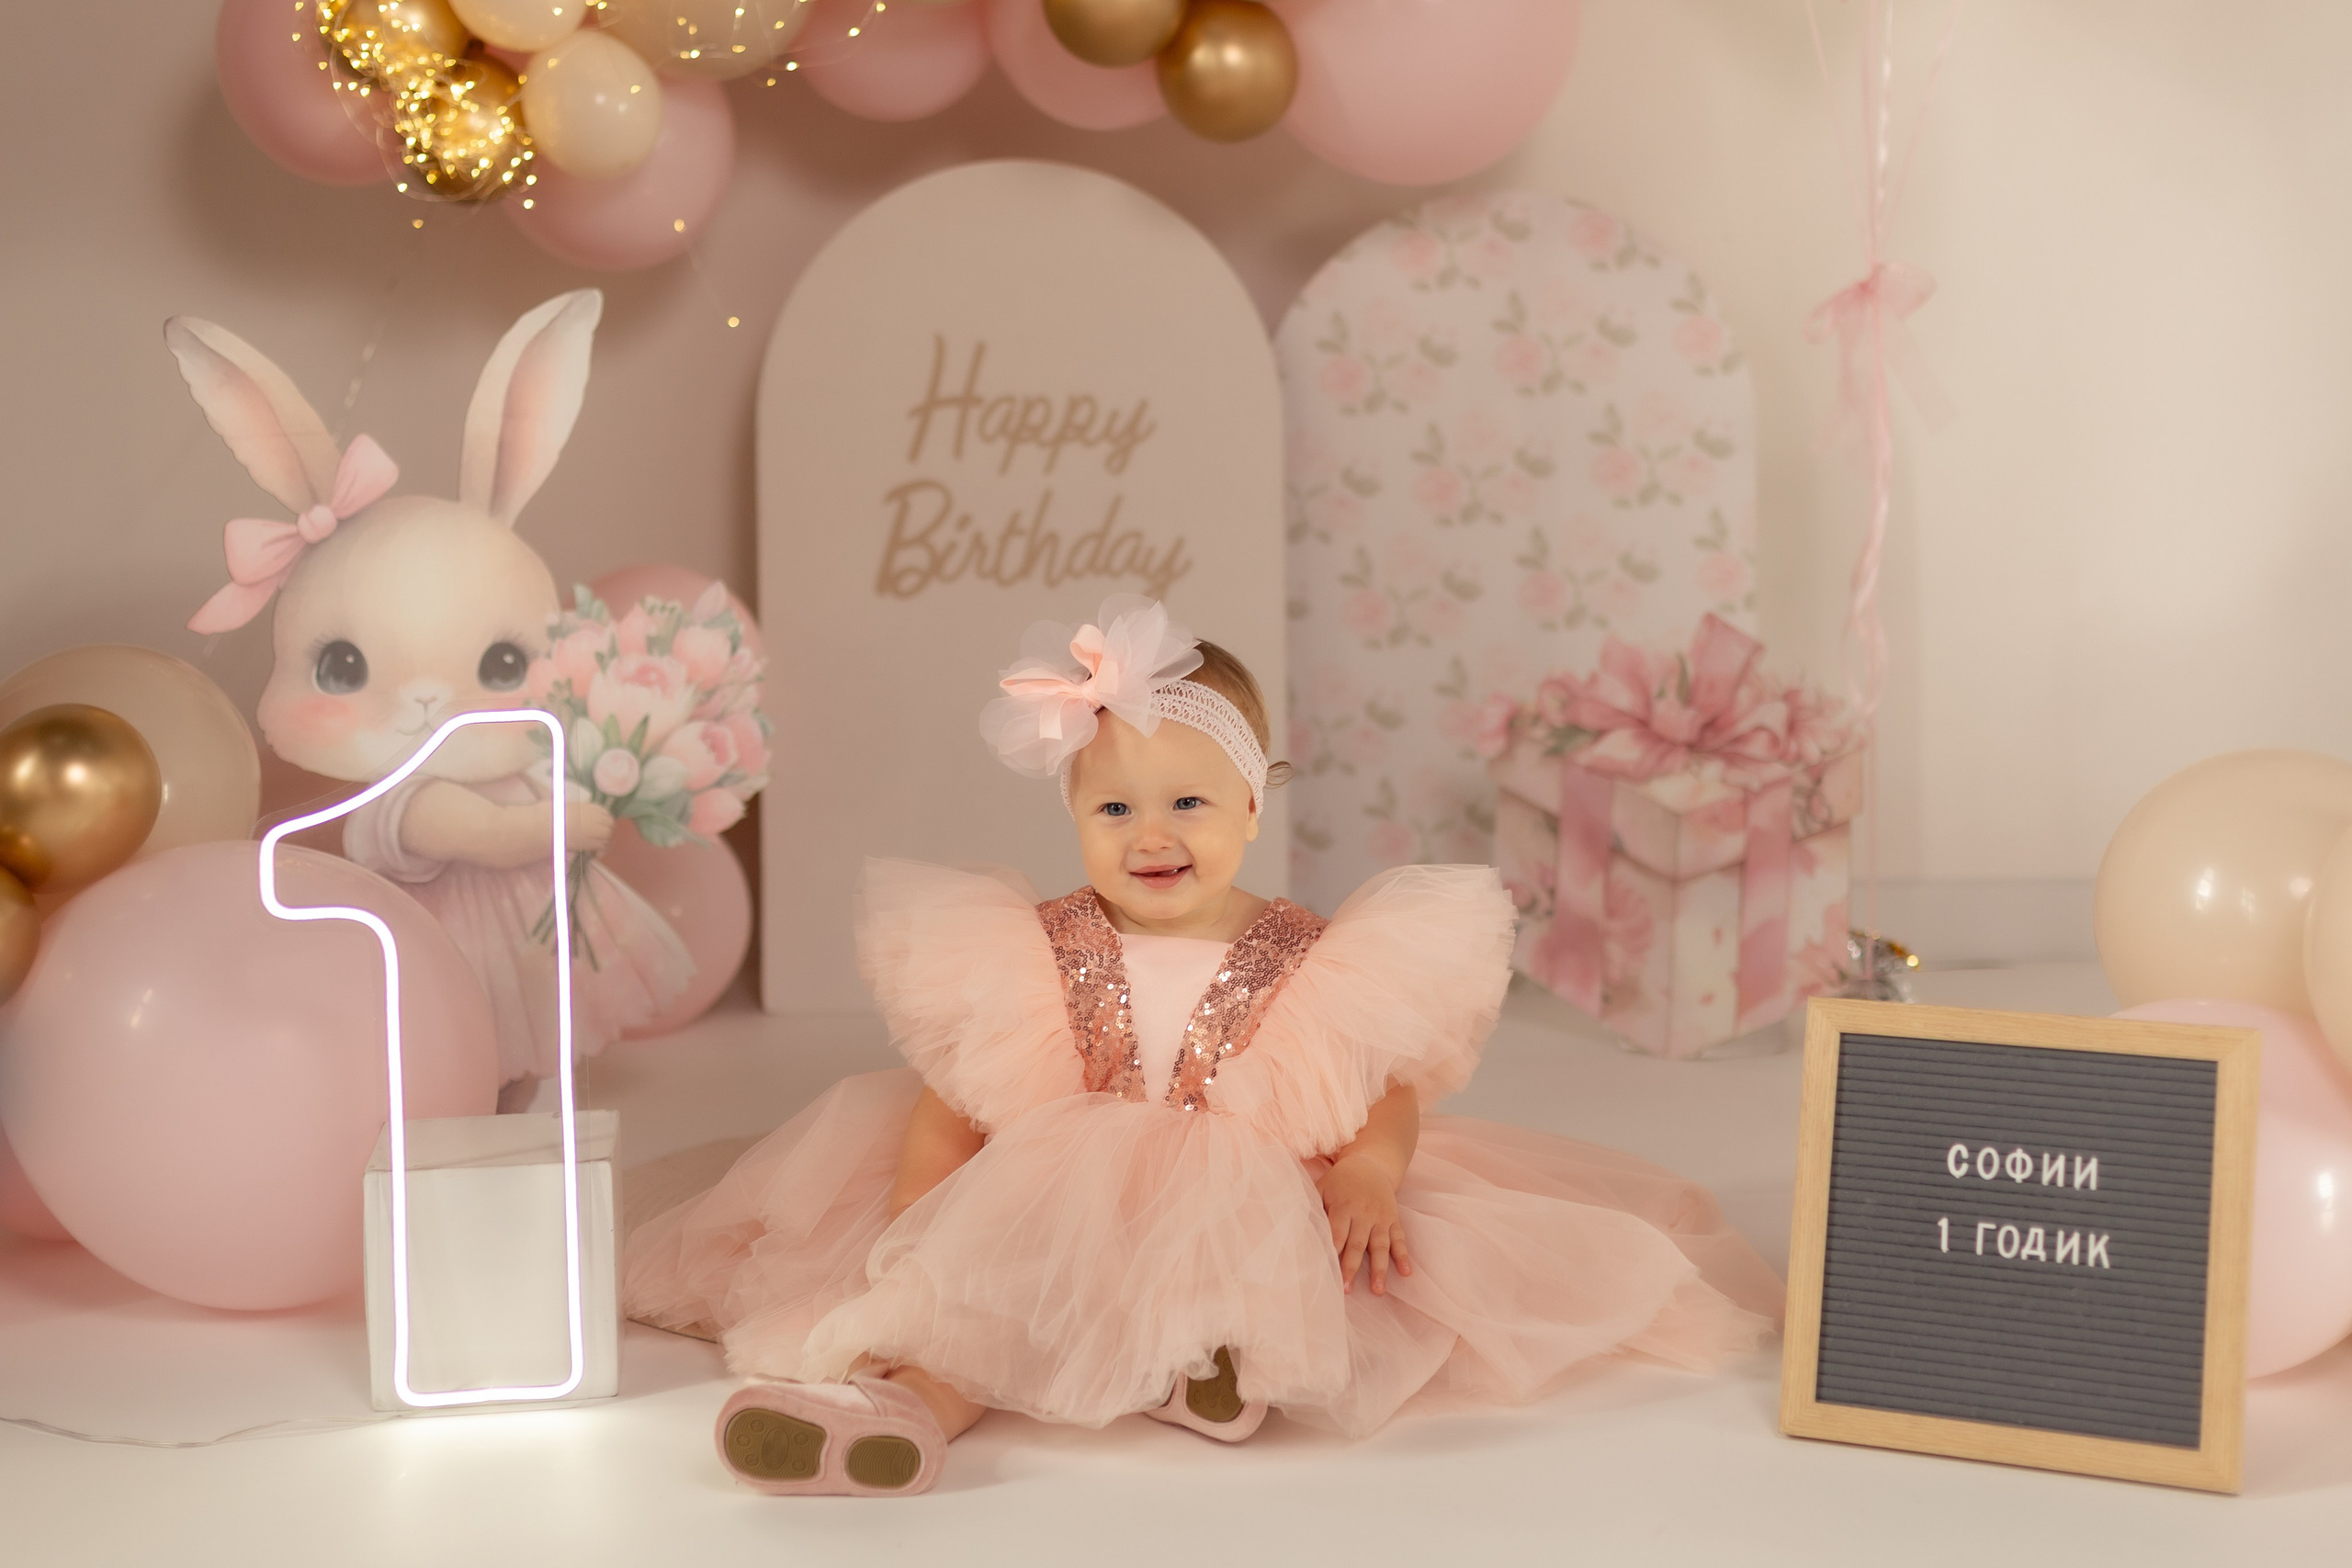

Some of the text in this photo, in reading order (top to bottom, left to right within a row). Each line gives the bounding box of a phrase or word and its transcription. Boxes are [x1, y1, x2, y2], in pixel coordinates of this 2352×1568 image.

[906, 333, 1157, 477] Happy
[875, 479, 1193, 602] Birthday
[258, 706, 584, 1408] 1
[1947, 1144, 2098, 1191] СОФИИ
[1938, 1217, 2110, 1269] 1 ГОДИК
